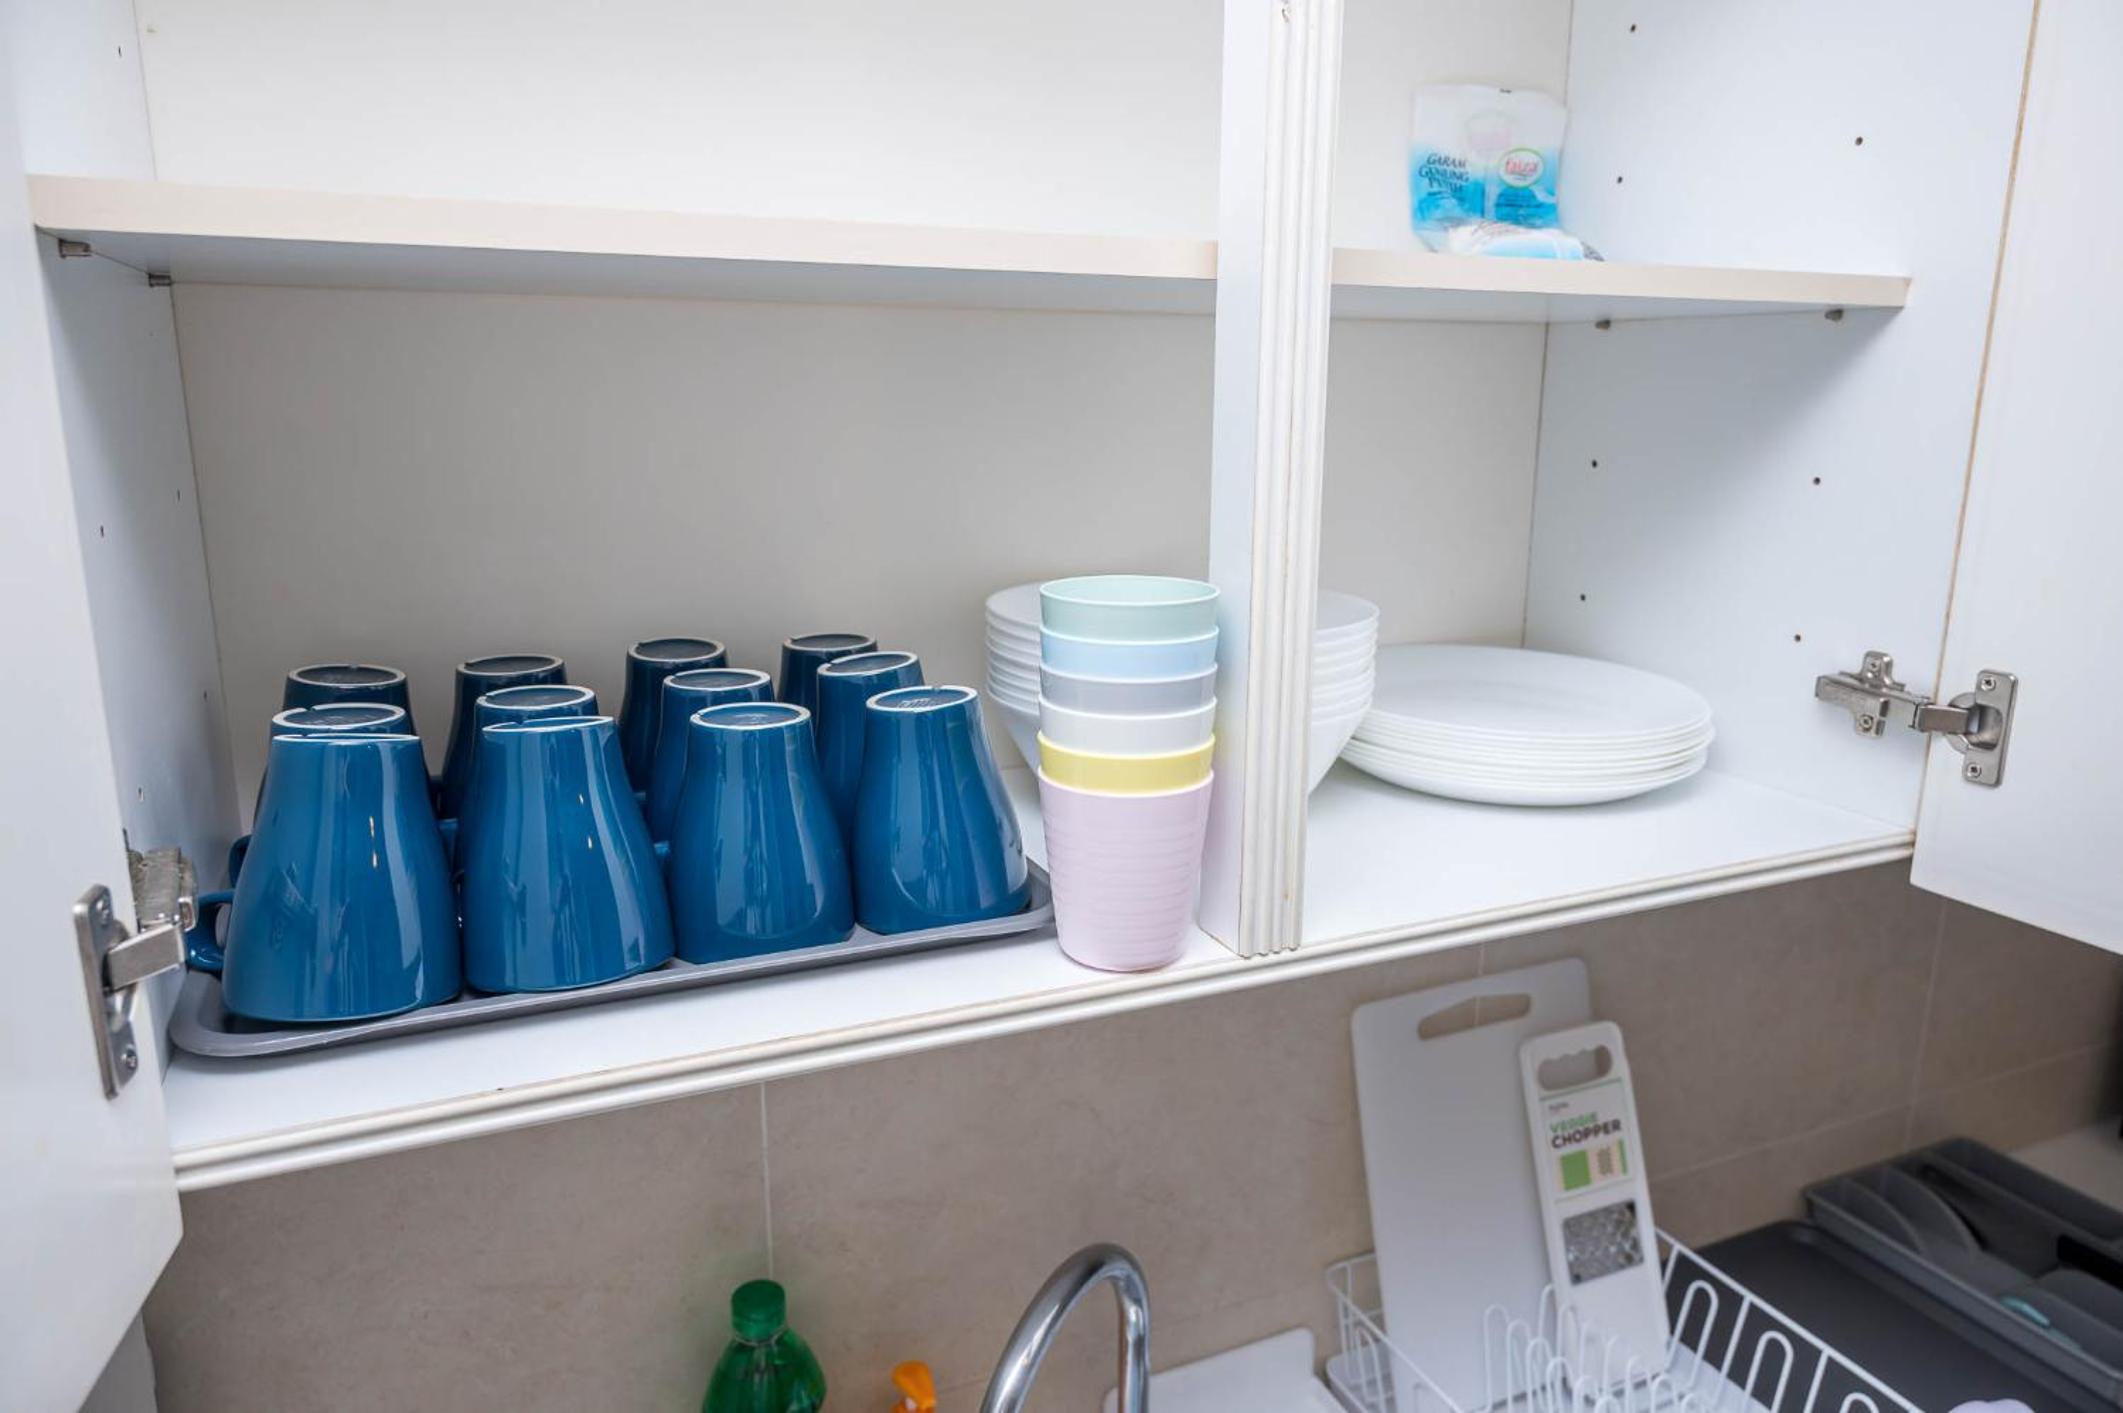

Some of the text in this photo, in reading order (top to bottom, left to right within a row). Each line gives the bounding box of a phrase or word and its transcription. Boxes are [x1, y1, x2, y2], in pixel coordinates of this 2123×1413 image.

[1426, 153, 1466, 169] GARAM
[1551, 1112, 1597, 1133] VEGGIE
[1552, 1119, 1621, 1148] CHOPPER
